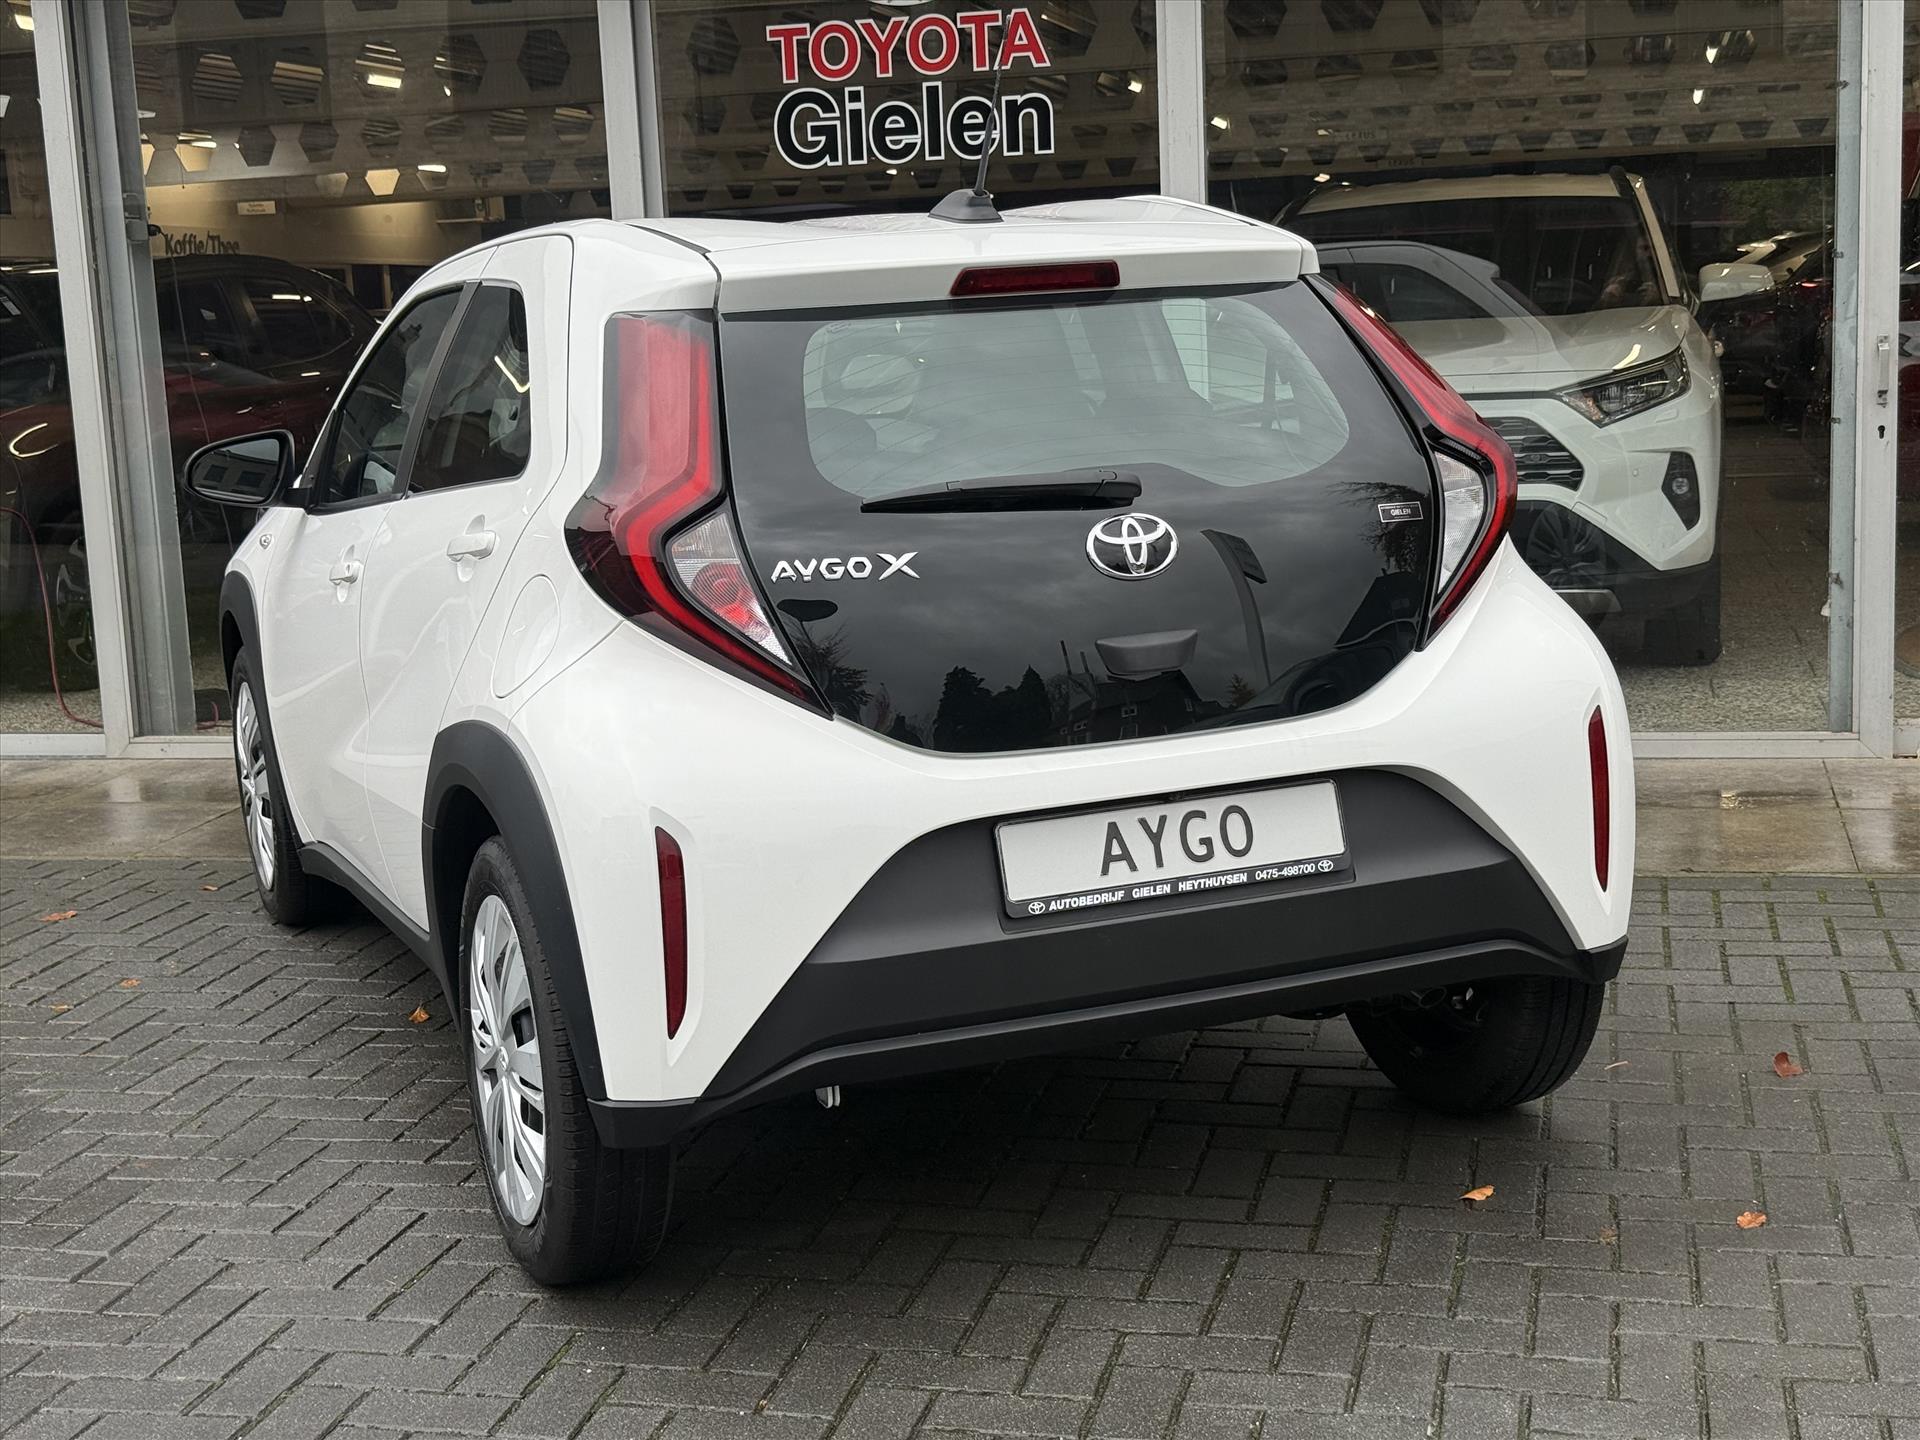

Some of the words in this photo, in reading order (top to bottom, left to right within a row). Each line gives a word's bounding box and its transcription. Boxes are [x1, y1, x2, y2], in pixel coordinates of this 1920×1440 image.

[766, 8, 1051, 84] TOYOTA
[773, 81, 1055, 170] Gielen
[770, 556, 873, 583] AYGO
[876, 551, 921, 581] X
[1100, 804, 1254, 876] AYGO
[1048, 890, 1125, 912] AUTOBEDRIJF
[1132, 883, 1171, 899] GIELEN
[1178, 872, 1248, 892] HEYTHUYSEN
[1255, 863, 1316, 881] 0475-498700
